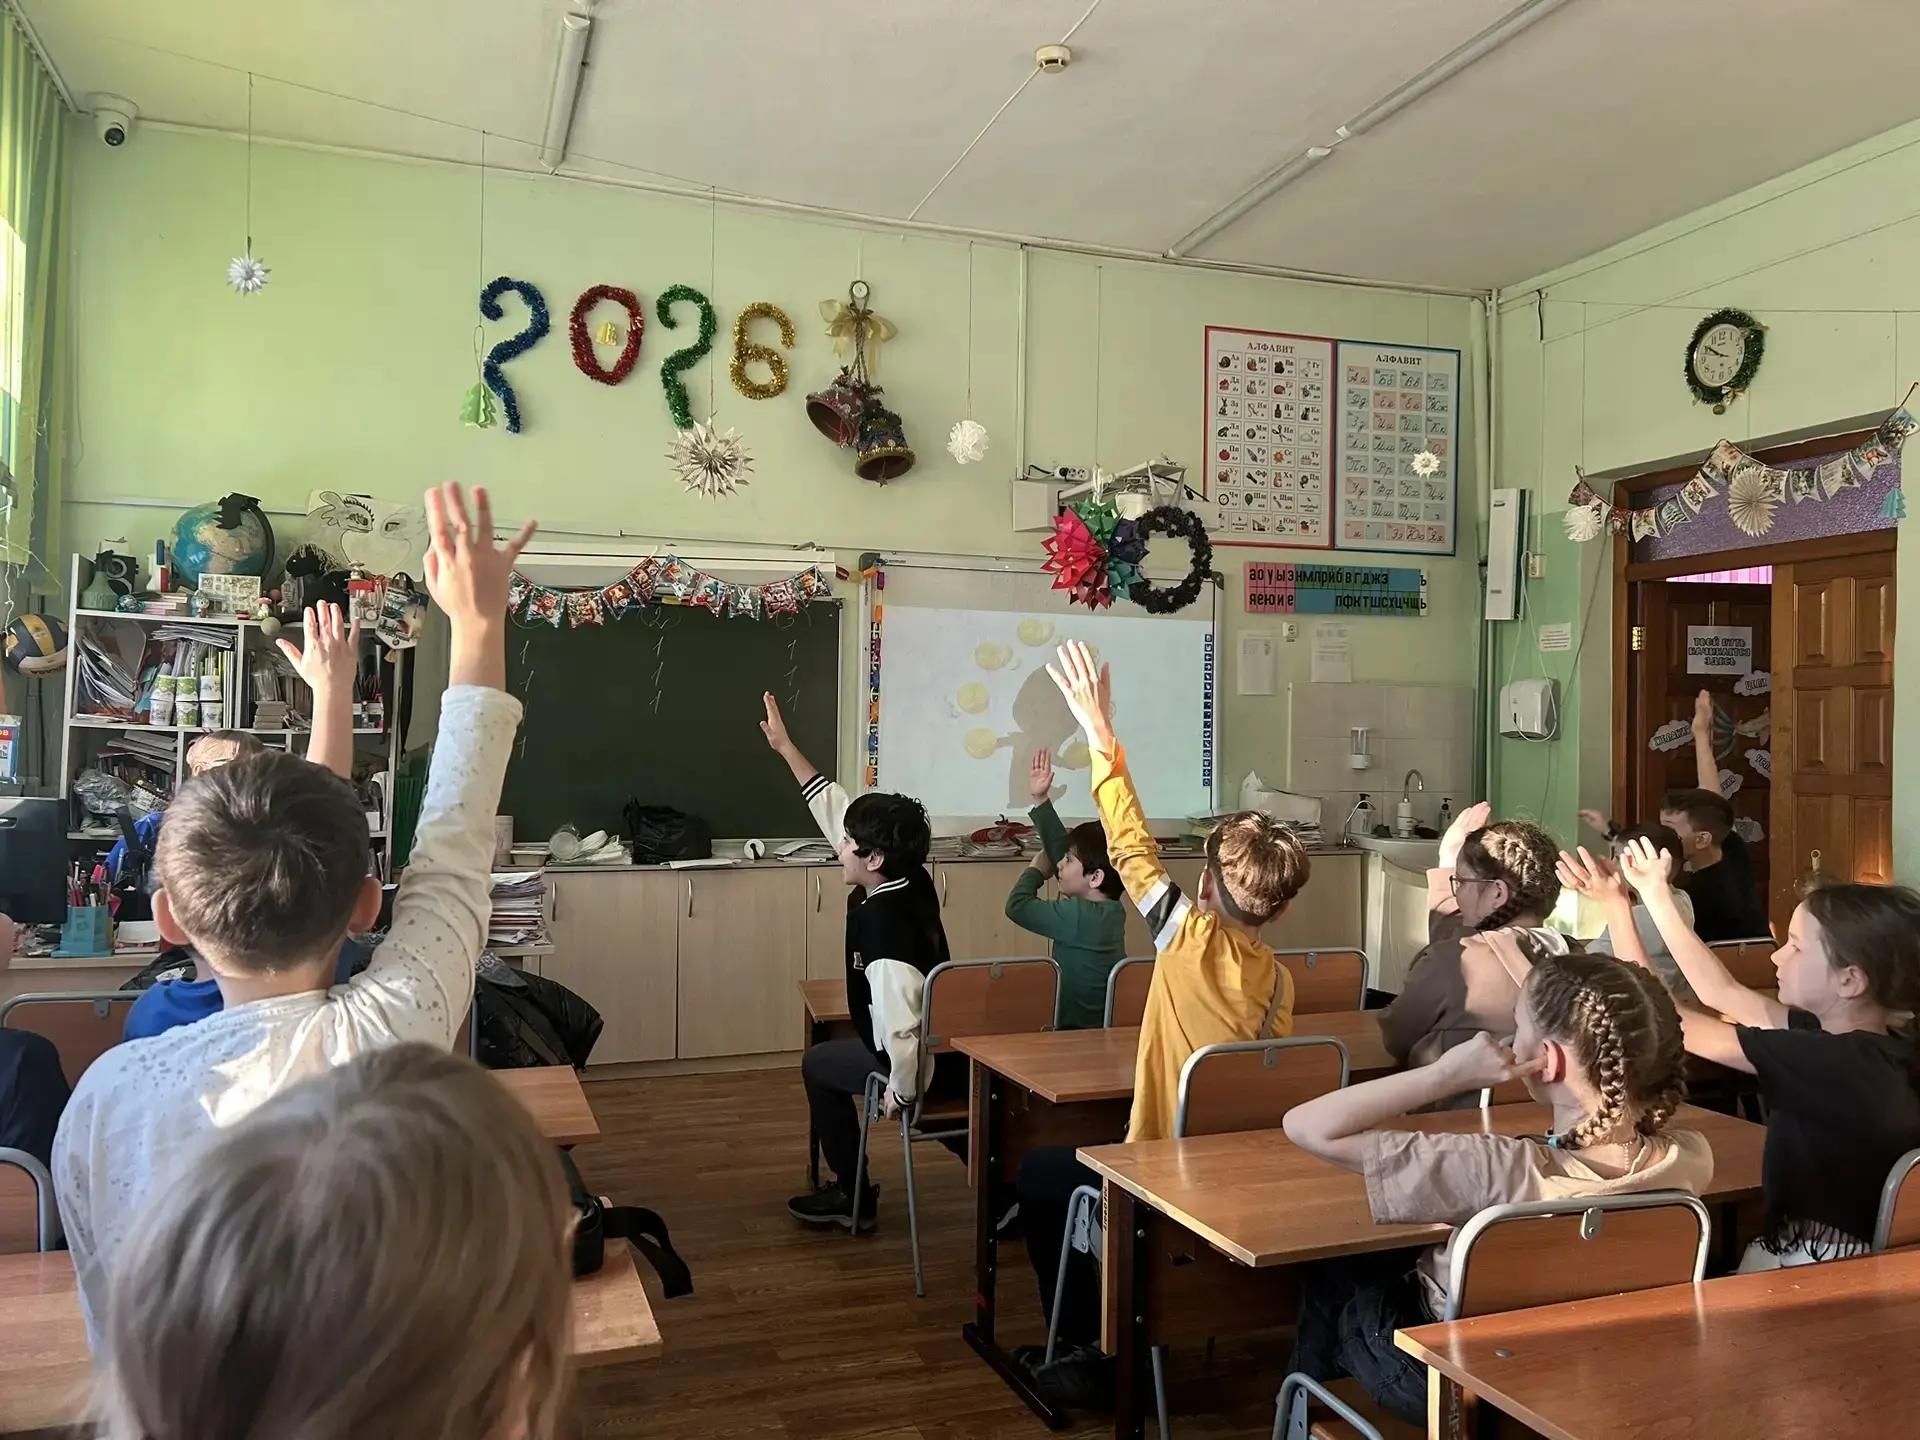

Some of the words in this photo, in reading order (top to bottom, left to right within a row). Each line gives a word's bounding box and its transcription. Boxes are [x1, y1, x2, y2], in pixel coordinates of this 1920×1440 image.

[1718, 331, 1726, 341] 12
[1247, 342, 1295, 353] АЛФАВИТ
[479, 276, 796, 434] 2026
[1376, 355, 1422, 365] АЛФАВИТ
[1693, 636, 1719, 647] ТВОЙ
[1722, 638, 1746, 647] ПУТЬ
[1688, 647, 1751, 657] НАЧИНАЕТСЯ
[1704, 657, 1736, 666] ЗДЕСЬ
[1745, 678, 1768, 690] ЦЕЛИ
[1653, 725, 1692, 746] ЖЕЛАНИЯ
